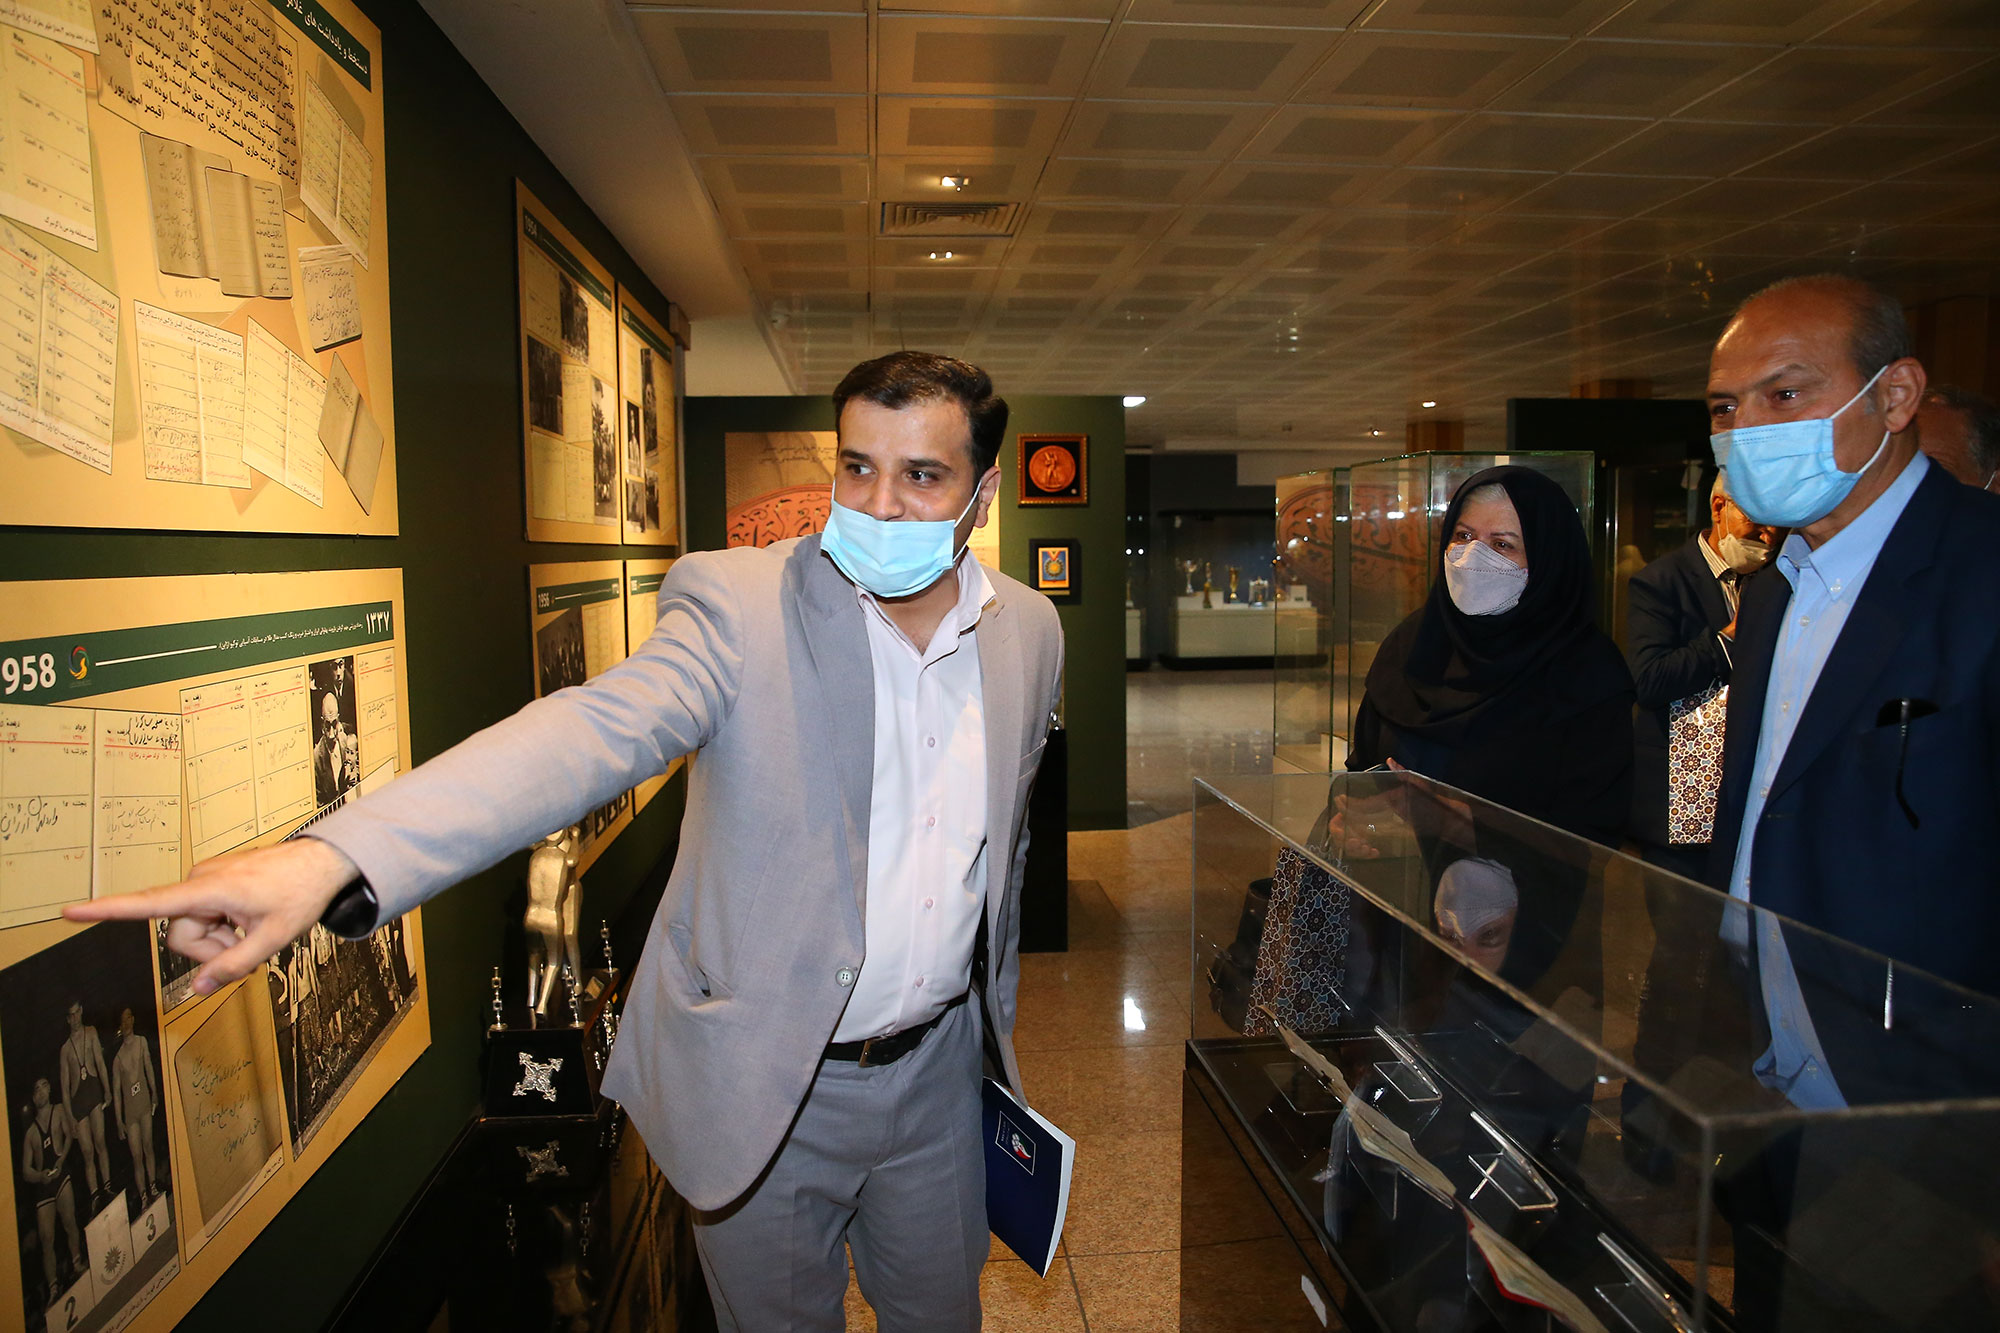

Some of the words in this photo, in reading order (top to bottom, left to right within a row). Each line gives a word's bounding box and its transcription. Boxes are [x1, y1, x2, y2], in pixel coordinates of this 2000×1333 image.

[305, 12, 316, 27] های
[318, 23, 342, 55] یادداشت
[343, 48, 347, 59] و
[348, 48, 367, 74] دستخط
[366, 611, 390, 634] ۱۳۳۷
[2, 653, 57, 695] 958
[145, 1213, 156, 1242] 3
[65, 1296, 79, 1332] 2
